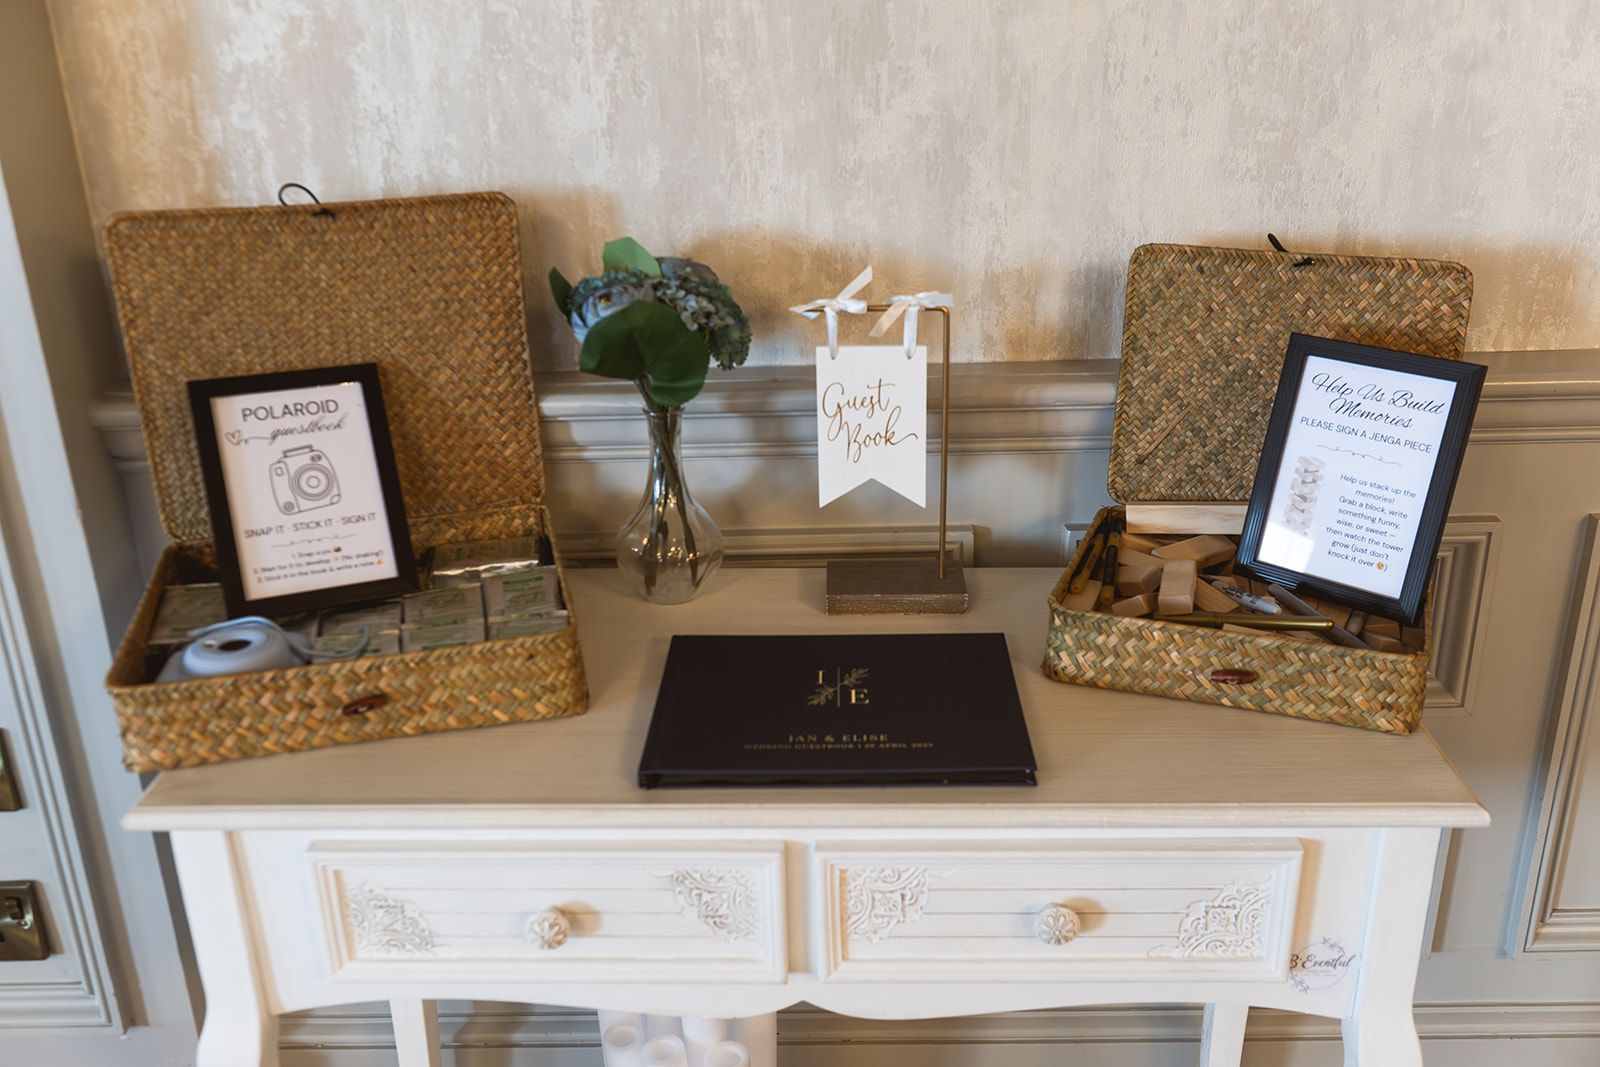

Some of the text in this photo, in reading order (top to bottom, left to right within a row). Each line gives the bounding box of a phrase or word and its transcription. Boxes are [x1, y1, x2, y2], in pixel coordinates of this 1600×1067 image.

[1311, 372, 1446, 415] Help Us Build
[241, 399, 339, 422] POLAROID
[822, 378, 896, 442] Guest
[1328, 398, 1413, 428] Memories
[268, 412, 349, 446] guestbook
[841, 405, 918, 464] Book
[1300, 416, 1433, 454] PLEASE SIGN A JENGA PIECE
[1340, 473, 1358, 485] Help
[1369, 479, 1390, 492] stack
[1391, 486, 1402, 496] up
[1403, 487, 1417, 498] the
[1355, 489, 1396, 504] memories!
[1338, 495, 1358, 507] Grab
[1388, 508, 1408, 520] write
[1338, 507, 1377, 524] something
[243, 512, 377, 539] SNAP IT STICK IT SIGN IT
[1365, 526, 1388, 538] sweet
[1326, 526, 1404, 553] then watch the tower
[1331, 540, 1350, 550] grow
[1350, 543, 1368, 556] (just
[1327, 550, 1350, 562] knock
[1350, 554, 1357, 563] it
[1357, 557, 1375, 568] over
[816, 669, 826, 685] I
[849, 688, 870, 704] E
[788, 733, 889, 743] IAN & ELISE
